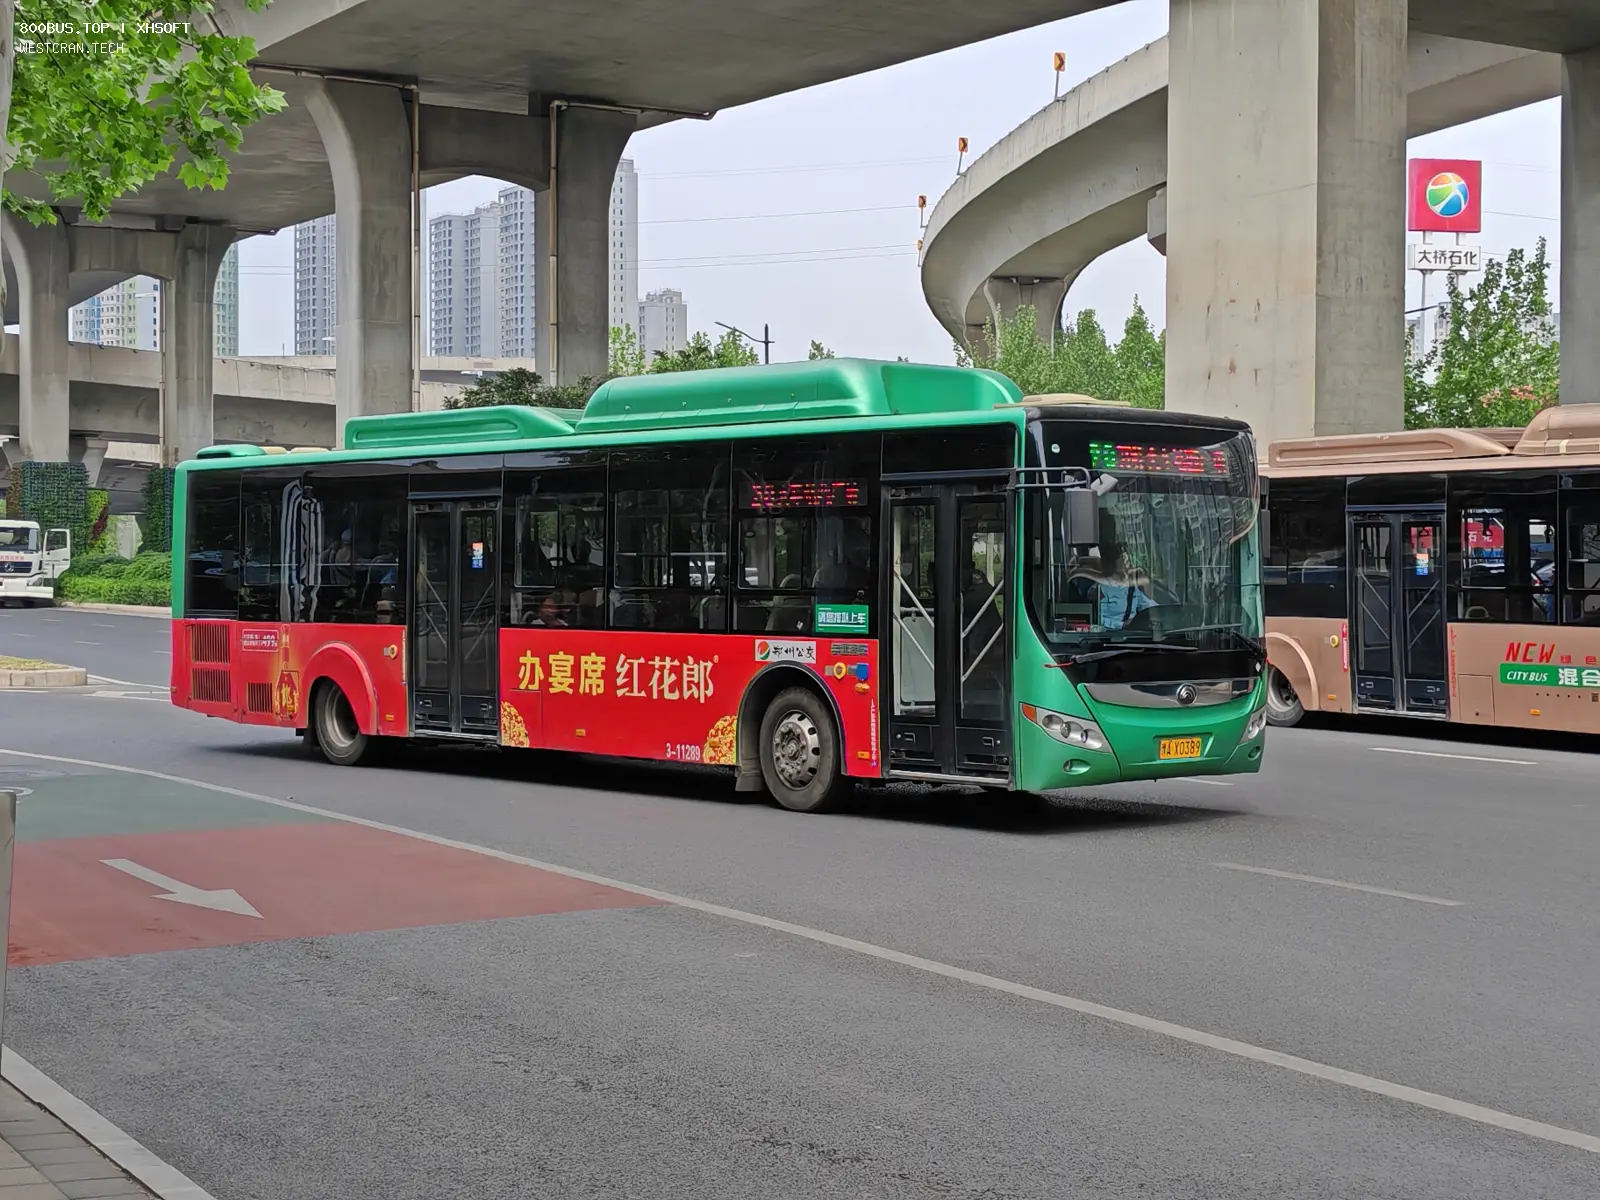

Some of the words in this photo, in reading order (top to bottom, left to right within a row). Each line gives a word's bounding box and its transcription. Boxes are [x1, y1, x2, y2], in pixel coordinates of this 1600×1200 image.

[1418, 249, 1477, 266] 大桥石化
[518, 650, 606, 696] 办宴席
[615, 652, 714, 704] 红花郎
[1506, 670, 1529, 681] CITY
[1529, 672, 1548, 682] BUS
[1558, 667, 1600, 687] 混合
[666, 742, 701, 761] 3-11289
